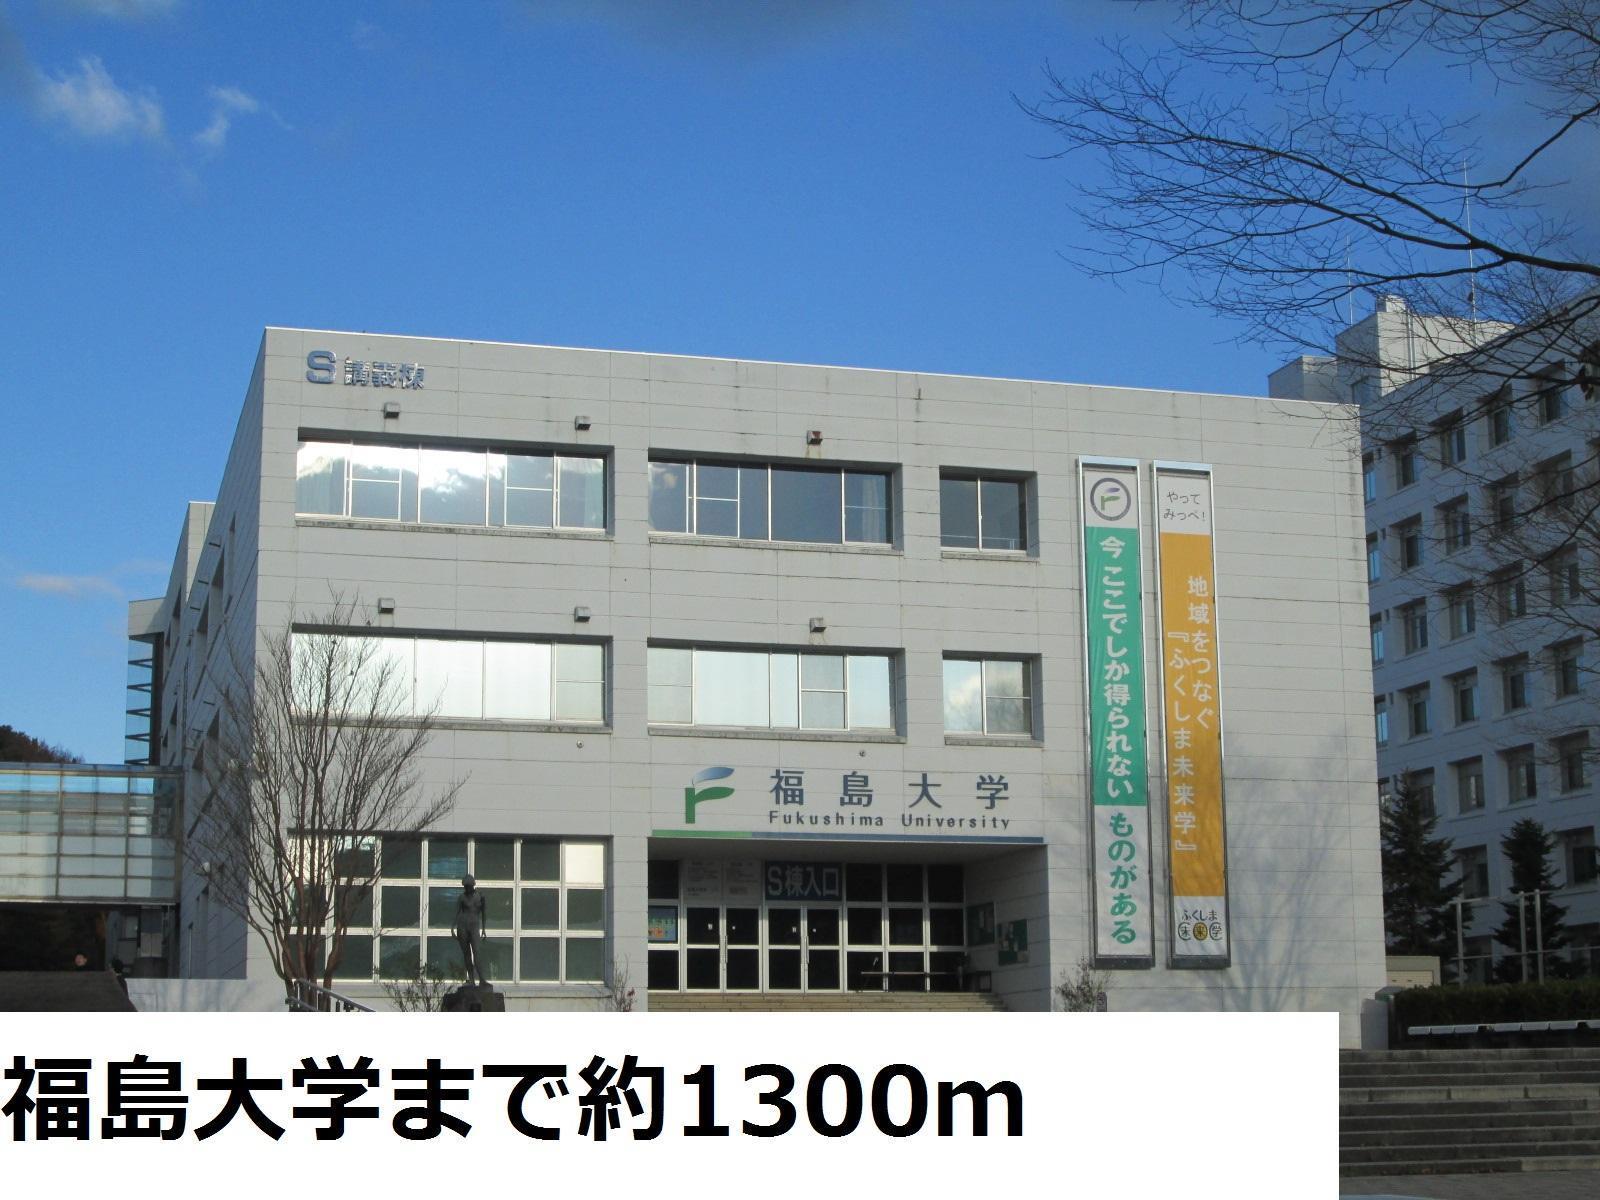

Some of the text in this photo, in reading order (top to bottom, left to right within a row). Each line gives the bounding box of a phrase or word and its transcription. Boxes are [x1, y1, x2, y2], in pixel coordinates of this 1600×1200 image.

[1166, 491, 1201, 506] やって
[1187, 575, 1214, 730] 地域をつなぐ
[1167, 631, 1197, 853] 『ふくしま未来学』
[769, 769, 1010, 810] 福島大学
[768, 811, 1010, 832] Fukushima University
[766, 865, 841, 897] S棟入口
[1182, 909, 1218, 922] ふくしま
